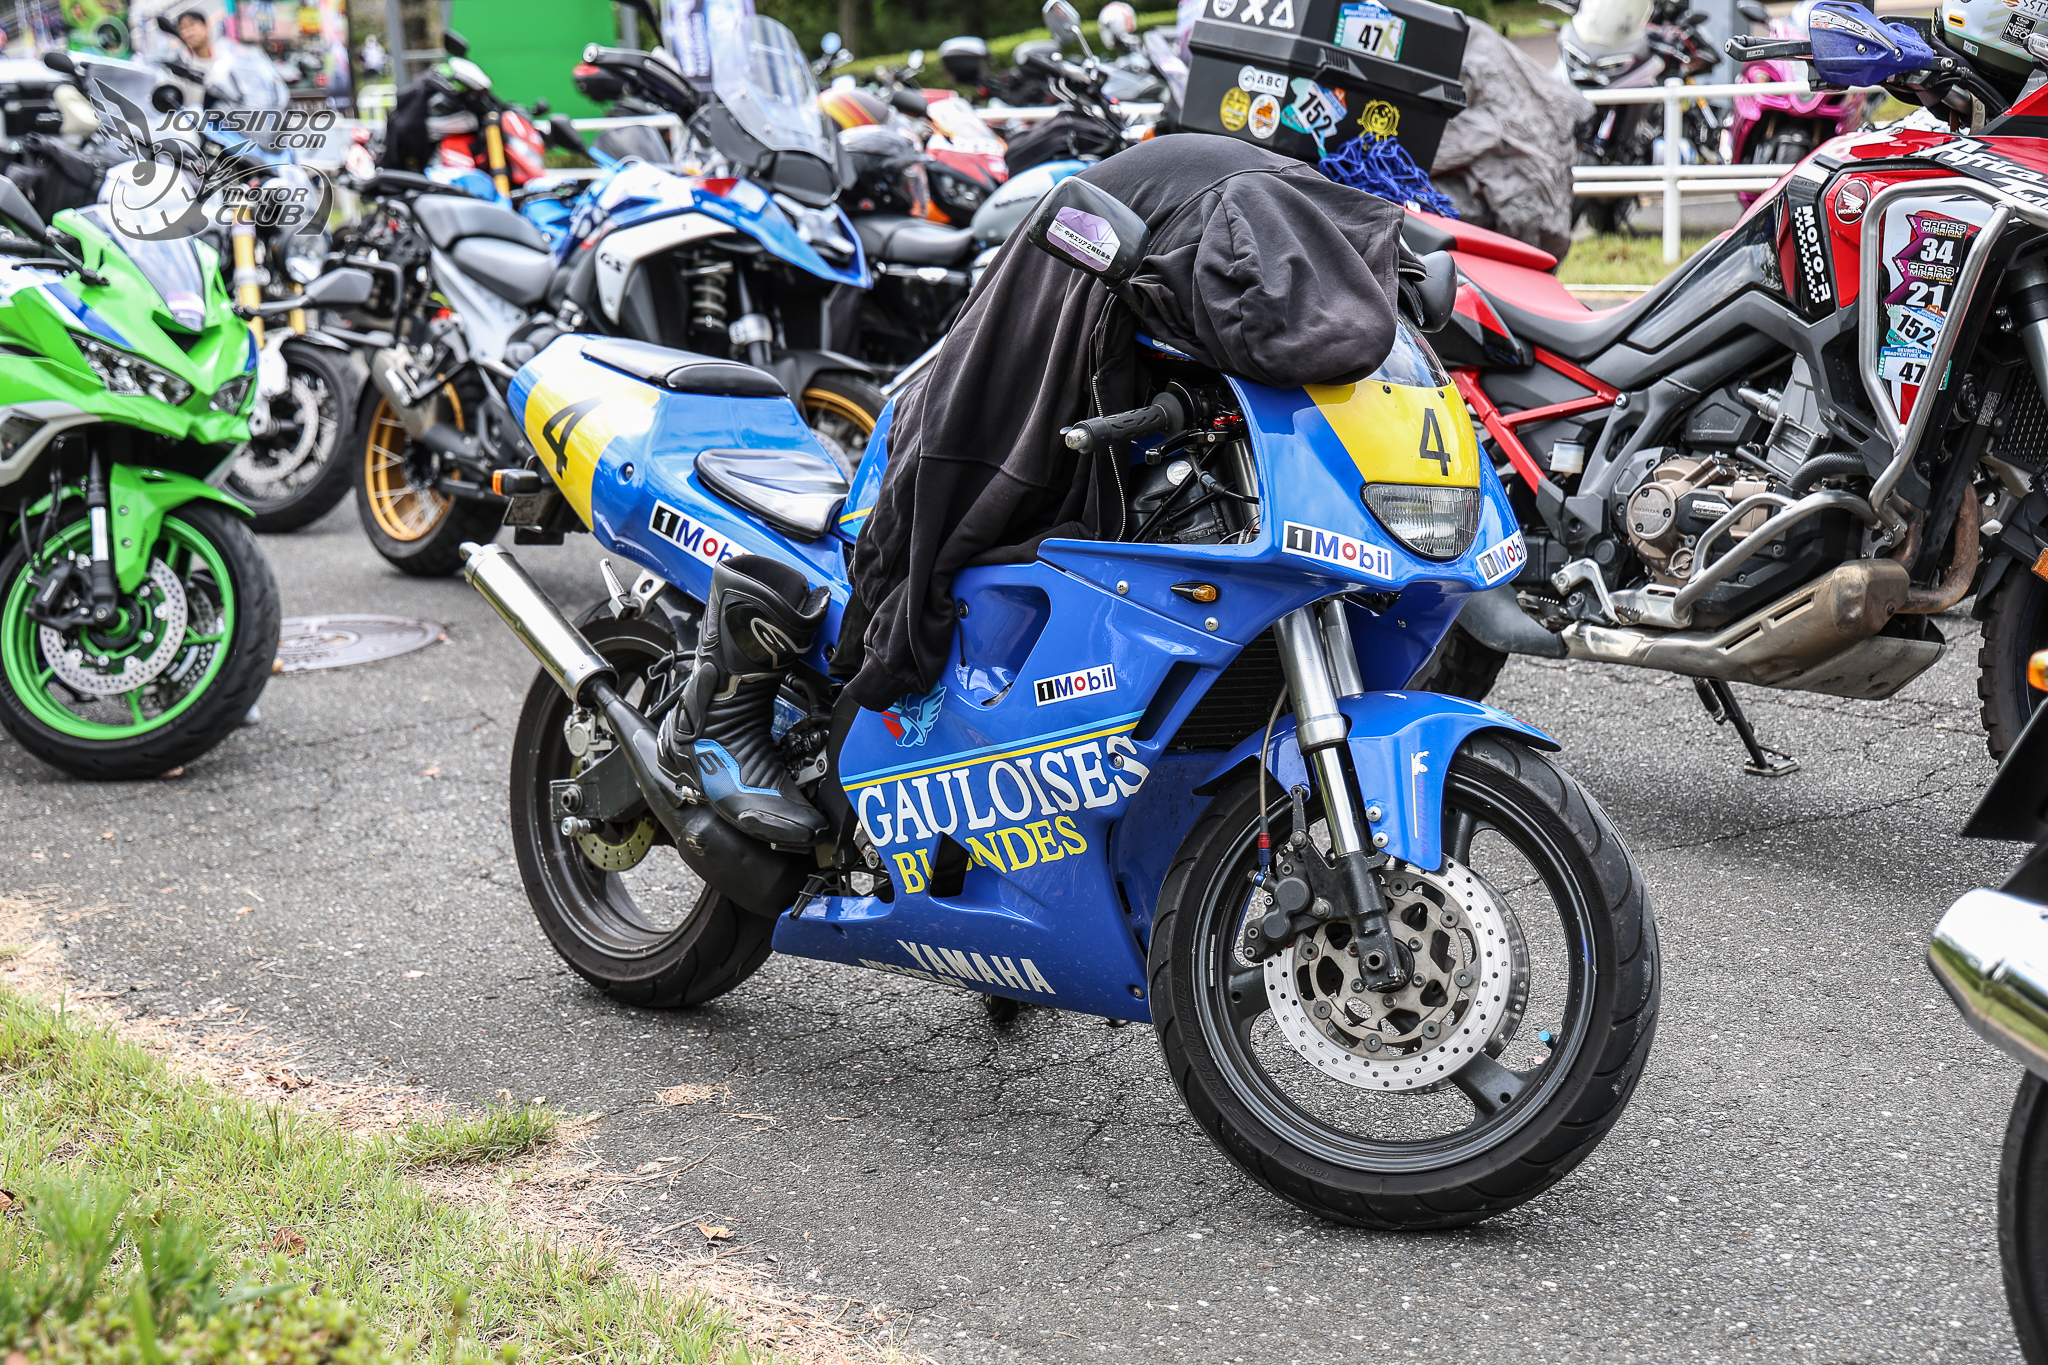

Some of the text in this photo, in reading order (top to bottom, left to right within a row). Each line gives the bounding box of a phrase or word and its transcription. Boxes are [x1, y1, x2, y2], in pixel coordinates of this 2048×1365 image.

[1358, 24, 1383, 51] 47
[2005, 26, 2029, 40] NEO
[1257, 75, 1281, 88] ABC
[1299, 92, 1332, 139] 152
[1909, 137, 2045, 182] Africa
[1921, 220, 1968, 233] CROSS
[1802, 205, 1832, 302] MOTO-R
[1908, 262, 1955, 277] CROSS
[1920, 238, 1955, 264] 34
[1906, 281, 1945, 307] 21
[1897, 314, 1935, 347] 152
[1898, 362, 1926, 384] 47
[542, 396, 602, 480] 4
[1419, 408, 1451, 477] 4
[676, 519, 748, 563] Mob
[1315, 532, 1389, 576] Mobil
[1492, 535, 1526, 574] Mobil
[1055, 667, 1113, 698] Mobil
[858, 735, 1150, 847] GAULOISES
[1417, 778, 1429, 856] MICHELIN
[893, 816, 1088, 894] BLNDES
[897, 939, 1056, 995] YAMAHA
[1175, 979, 1229, 1100] MICHELIN
[1294, 1161, 1329, 1179] FRONT
